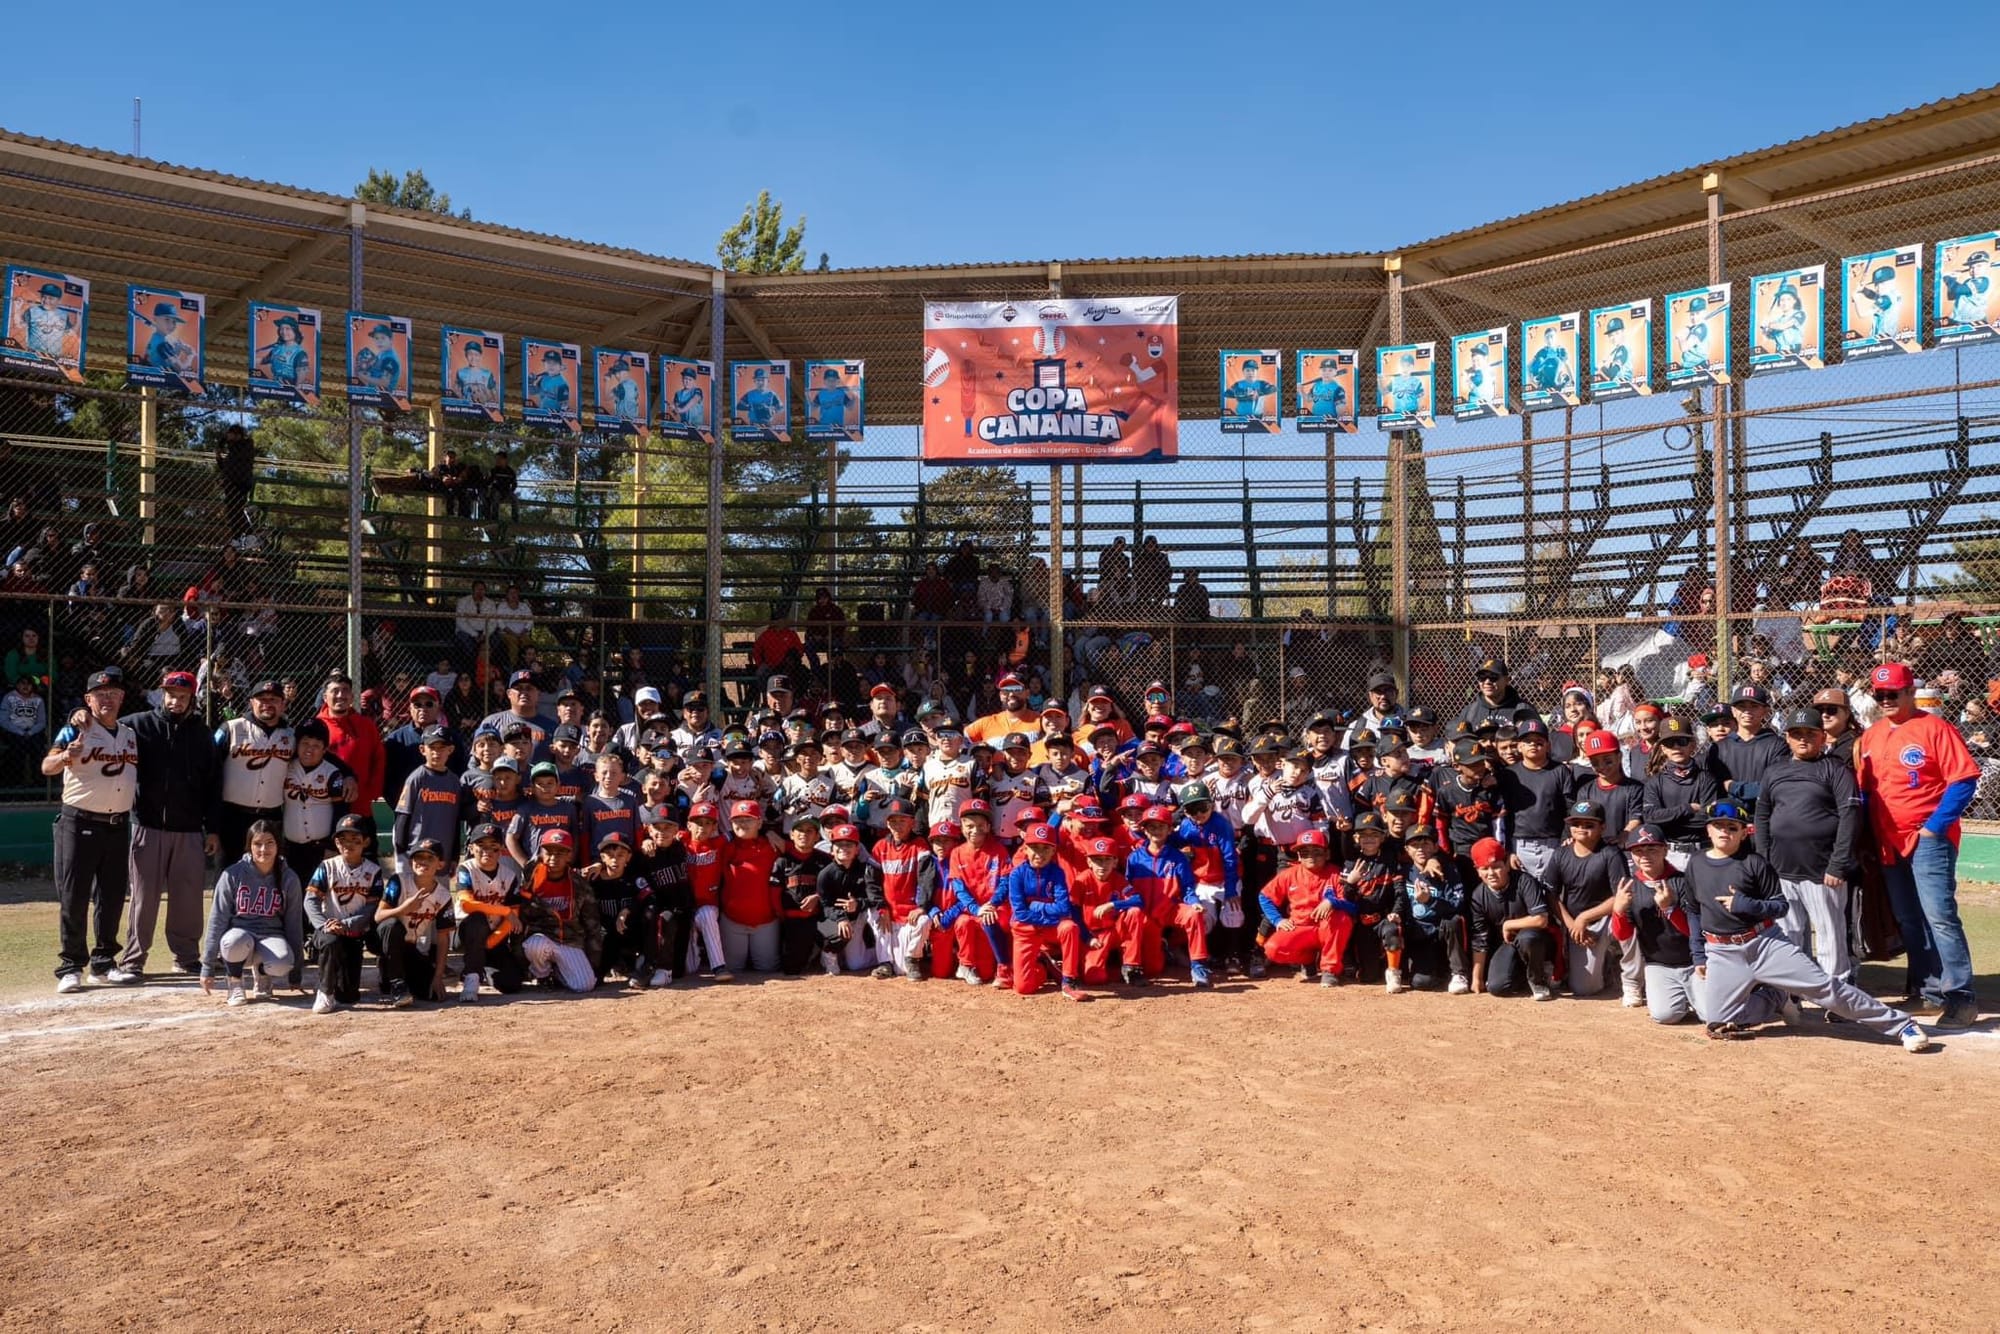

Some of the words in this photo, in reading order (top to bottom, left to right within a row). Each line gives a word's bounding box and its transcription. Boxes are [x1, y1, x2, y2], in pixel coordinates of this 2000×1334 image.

[1007, 387, 1087, 411] COPA
[978, 413, 1121, 440] CANANEA
[968, 447, 1002, 455] Academia
[1041, 447, 1080, 456] Naranjeros
[1085, 447, 1107, 456] Grupo
[1875, 668, 1890, 682] C
[80, 745, 138, 777] Naranjero
[1907, 771, 1920, 788] 3
[236, 884, 284, 918] GAP
